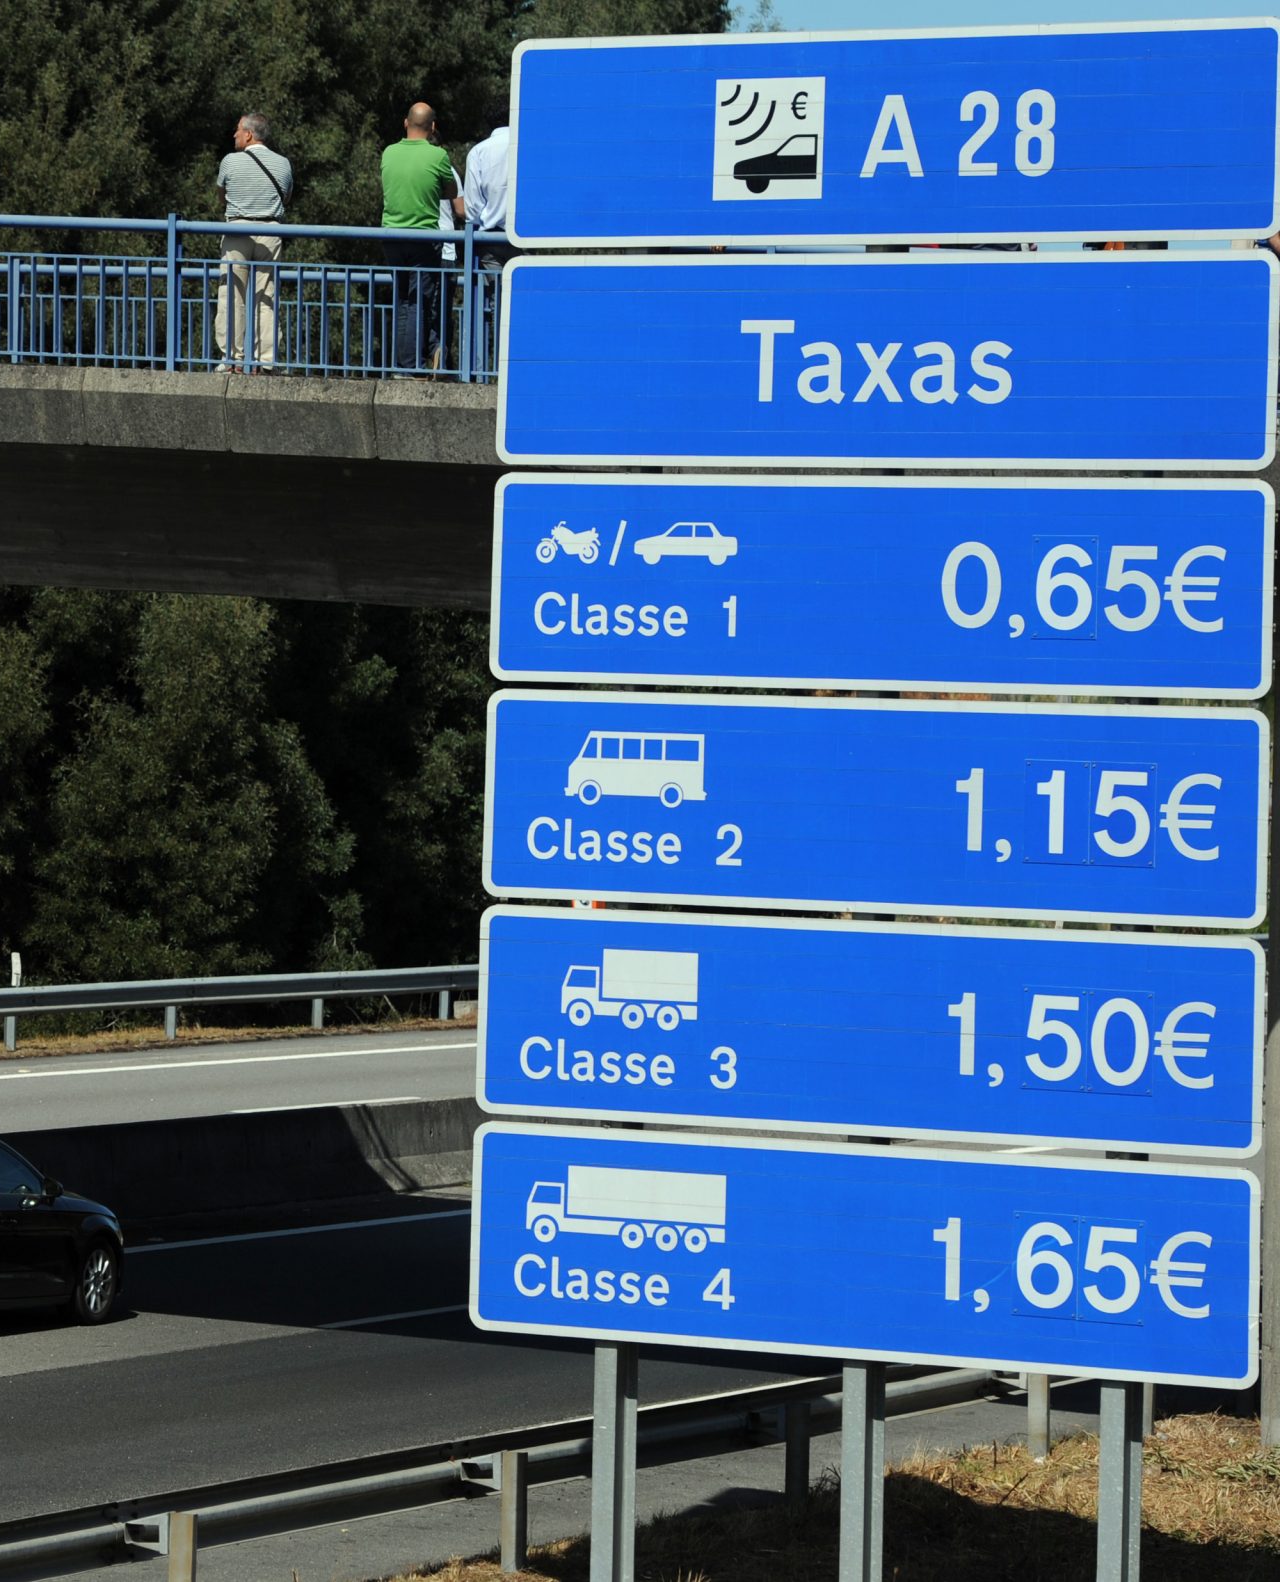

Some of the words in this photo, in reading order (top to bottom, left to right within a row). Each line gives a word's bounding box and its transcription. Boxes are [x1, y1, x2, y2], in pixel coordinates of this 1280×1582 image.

[791, 92, 809, 120] €
[860, 95, 924, 178] A
[959, 89, 1056, 177] 28
[741, 320, 1013, 405] Taxas
[535, 591, 689, 637] Classe
[723, 595, 738, 637] 1
[942, 541, 1227, 638] 0,65€
[527, 816, 682, 865] Classe
[716, 823, 743, 866] 2
[956, 768, 1222, 863] 1,15€
[520, 1036, 675, 1087] Classe
[710, 1046, 738, 1090] 3
[948, 992, 1217, 1089] 1,50€
[514, 1254, 670, 1306] Classe
[702, 1268, 736, 1311] 4
[933, 1217, 1213, 1319] 1,65€
